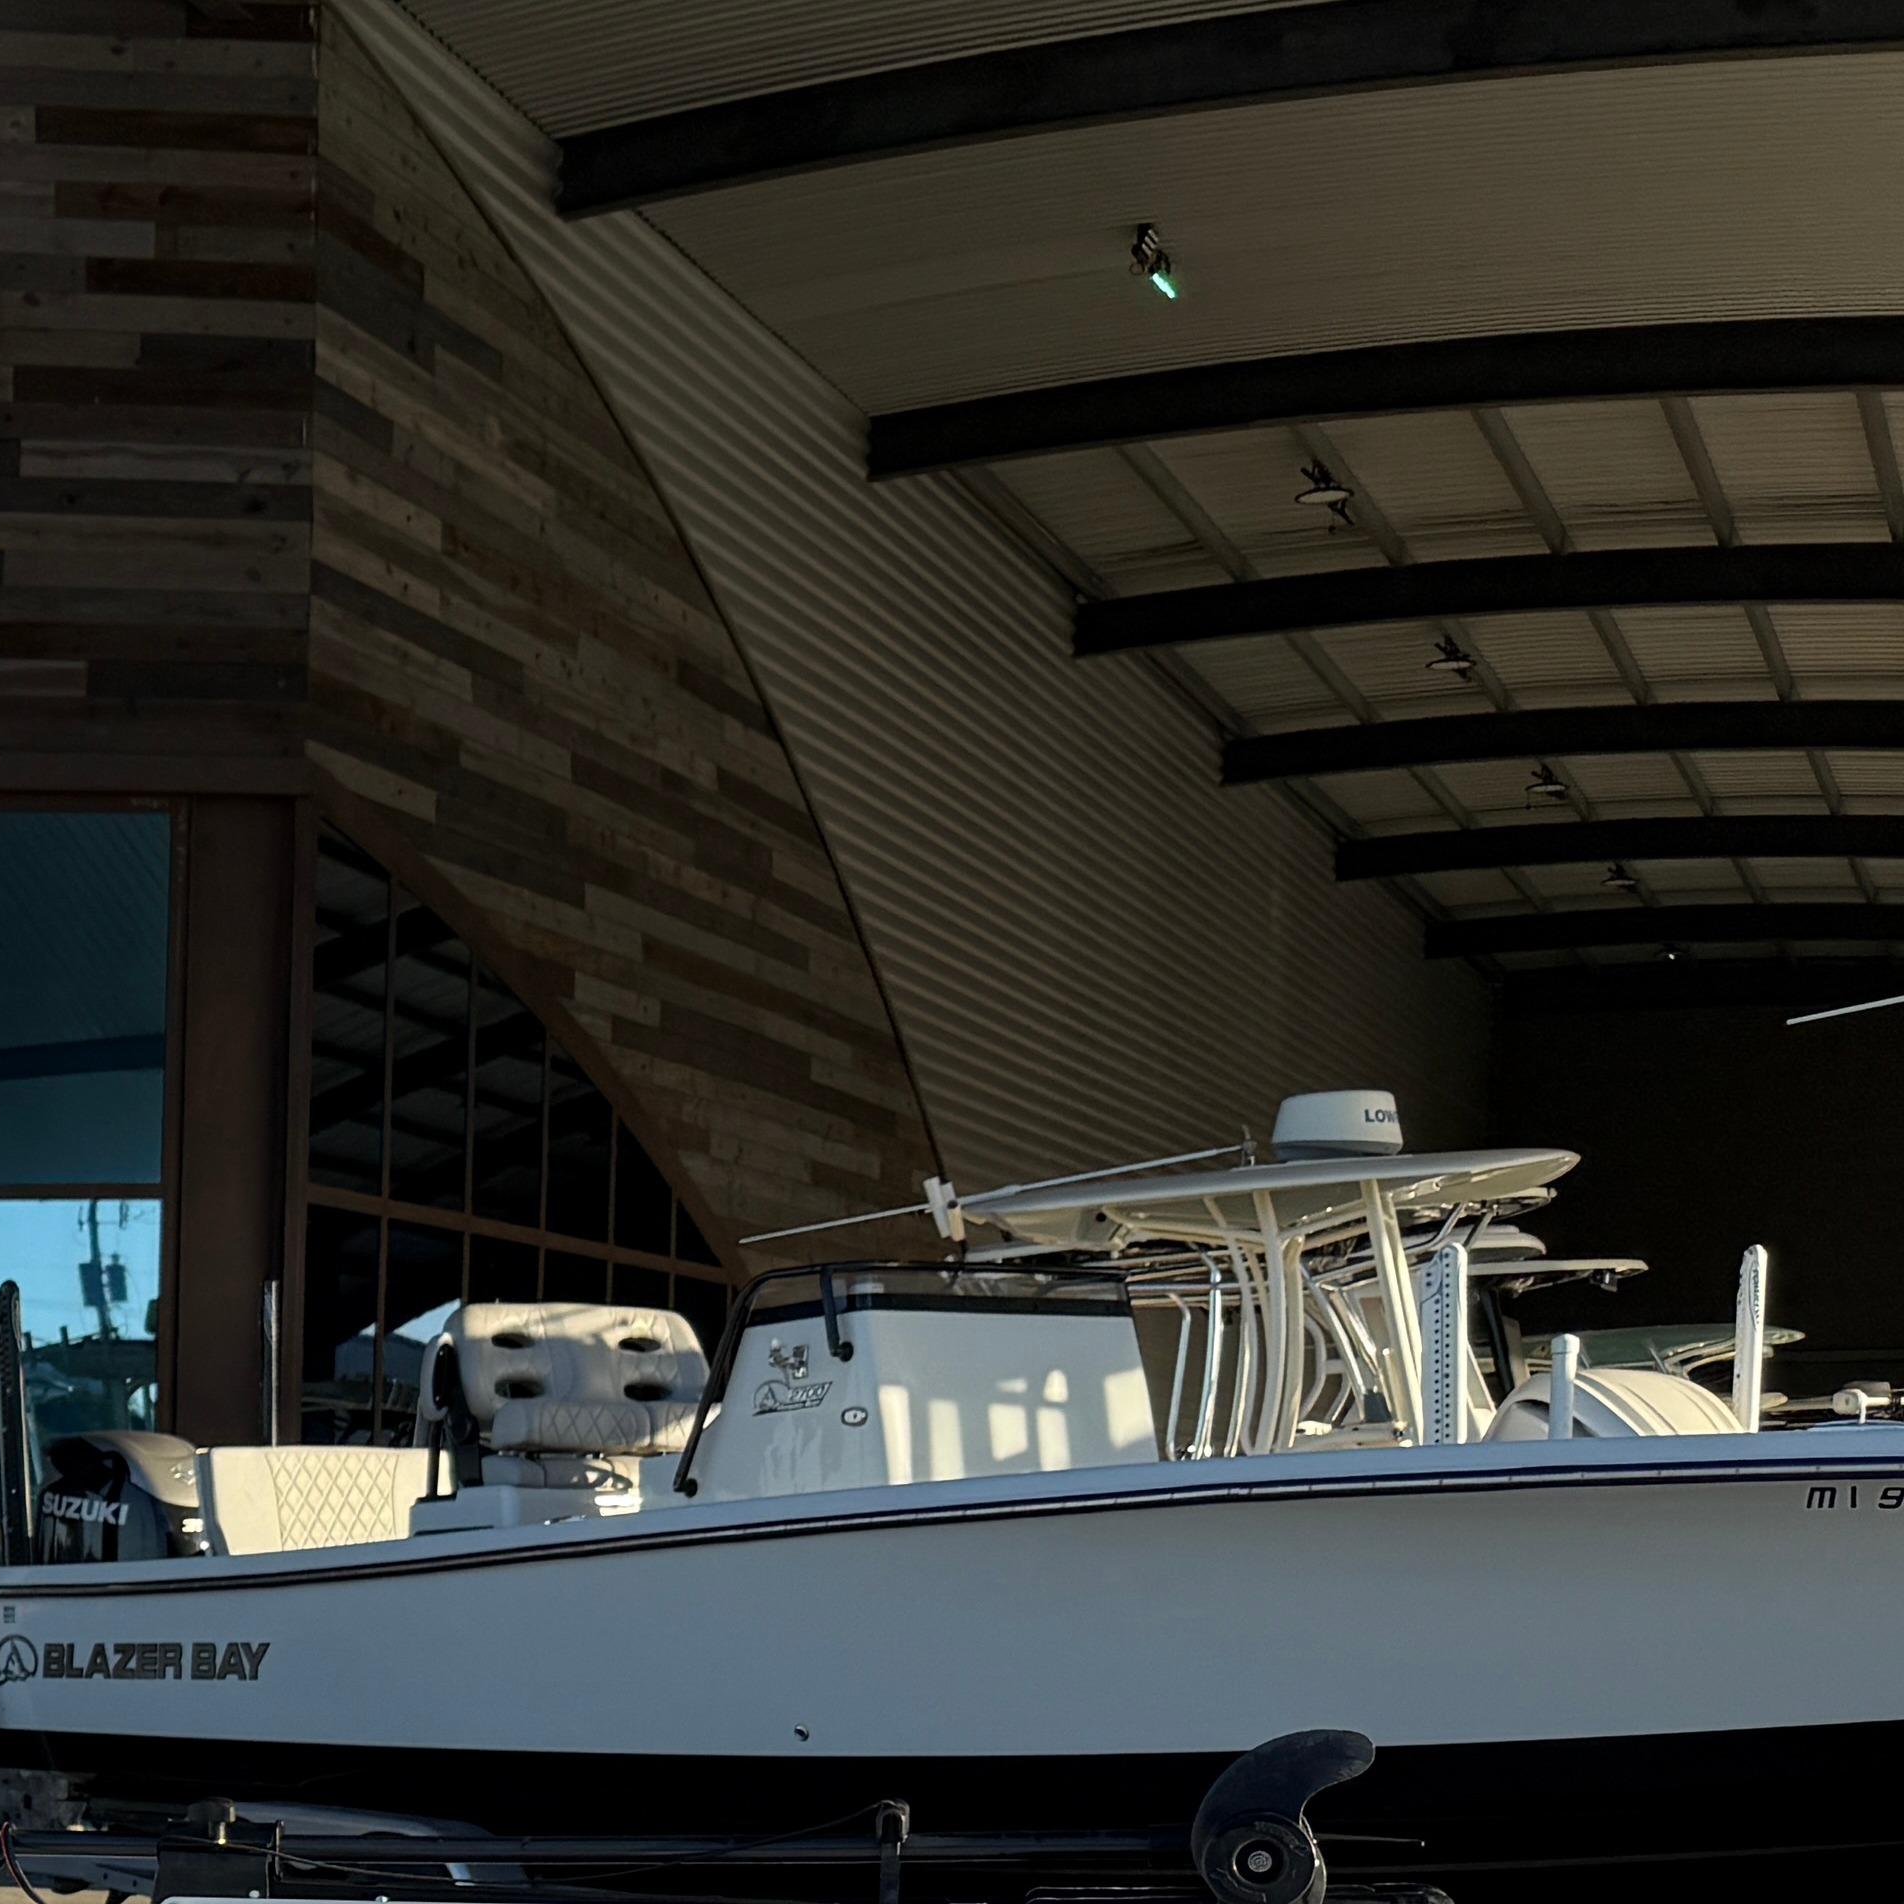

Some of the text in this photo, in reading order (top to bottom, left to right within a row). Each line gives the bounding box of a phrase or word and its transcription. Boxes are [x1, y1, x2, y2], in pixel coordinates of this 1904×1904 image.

[43, 1493, 129, 1526] SUZUKI
[42, 1642, 271, 1681] BLAZER BAY
